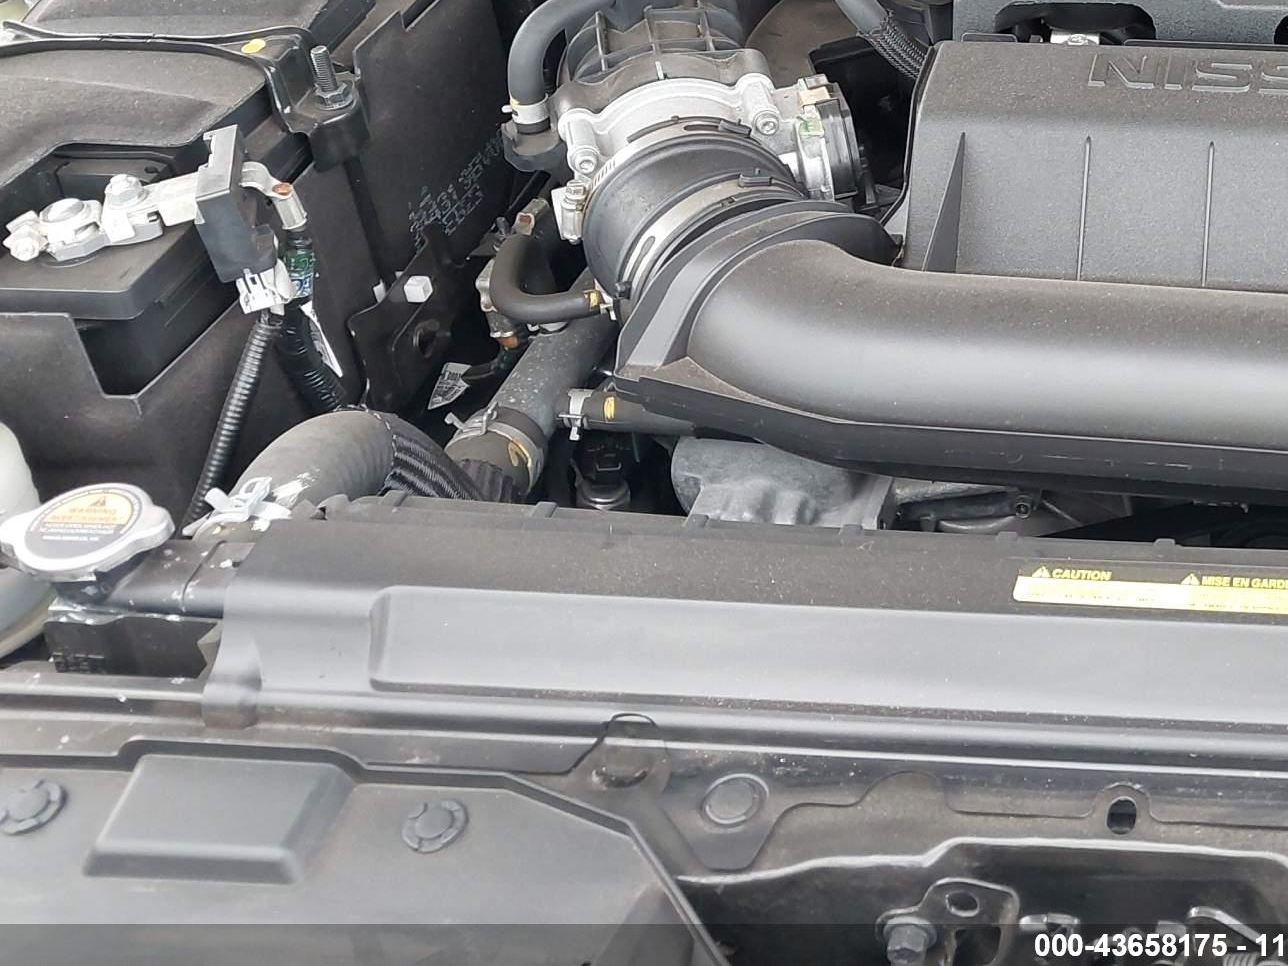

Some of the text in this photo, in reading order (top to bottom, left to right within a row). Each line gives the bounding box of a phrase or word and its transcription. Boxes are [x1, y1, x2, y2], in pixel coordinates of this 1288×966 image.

[1052, 569, 1112, 581] CAUTION
[1202, 576, 1231, 587] MISE
[1232, 577, 1250, 588] EN
